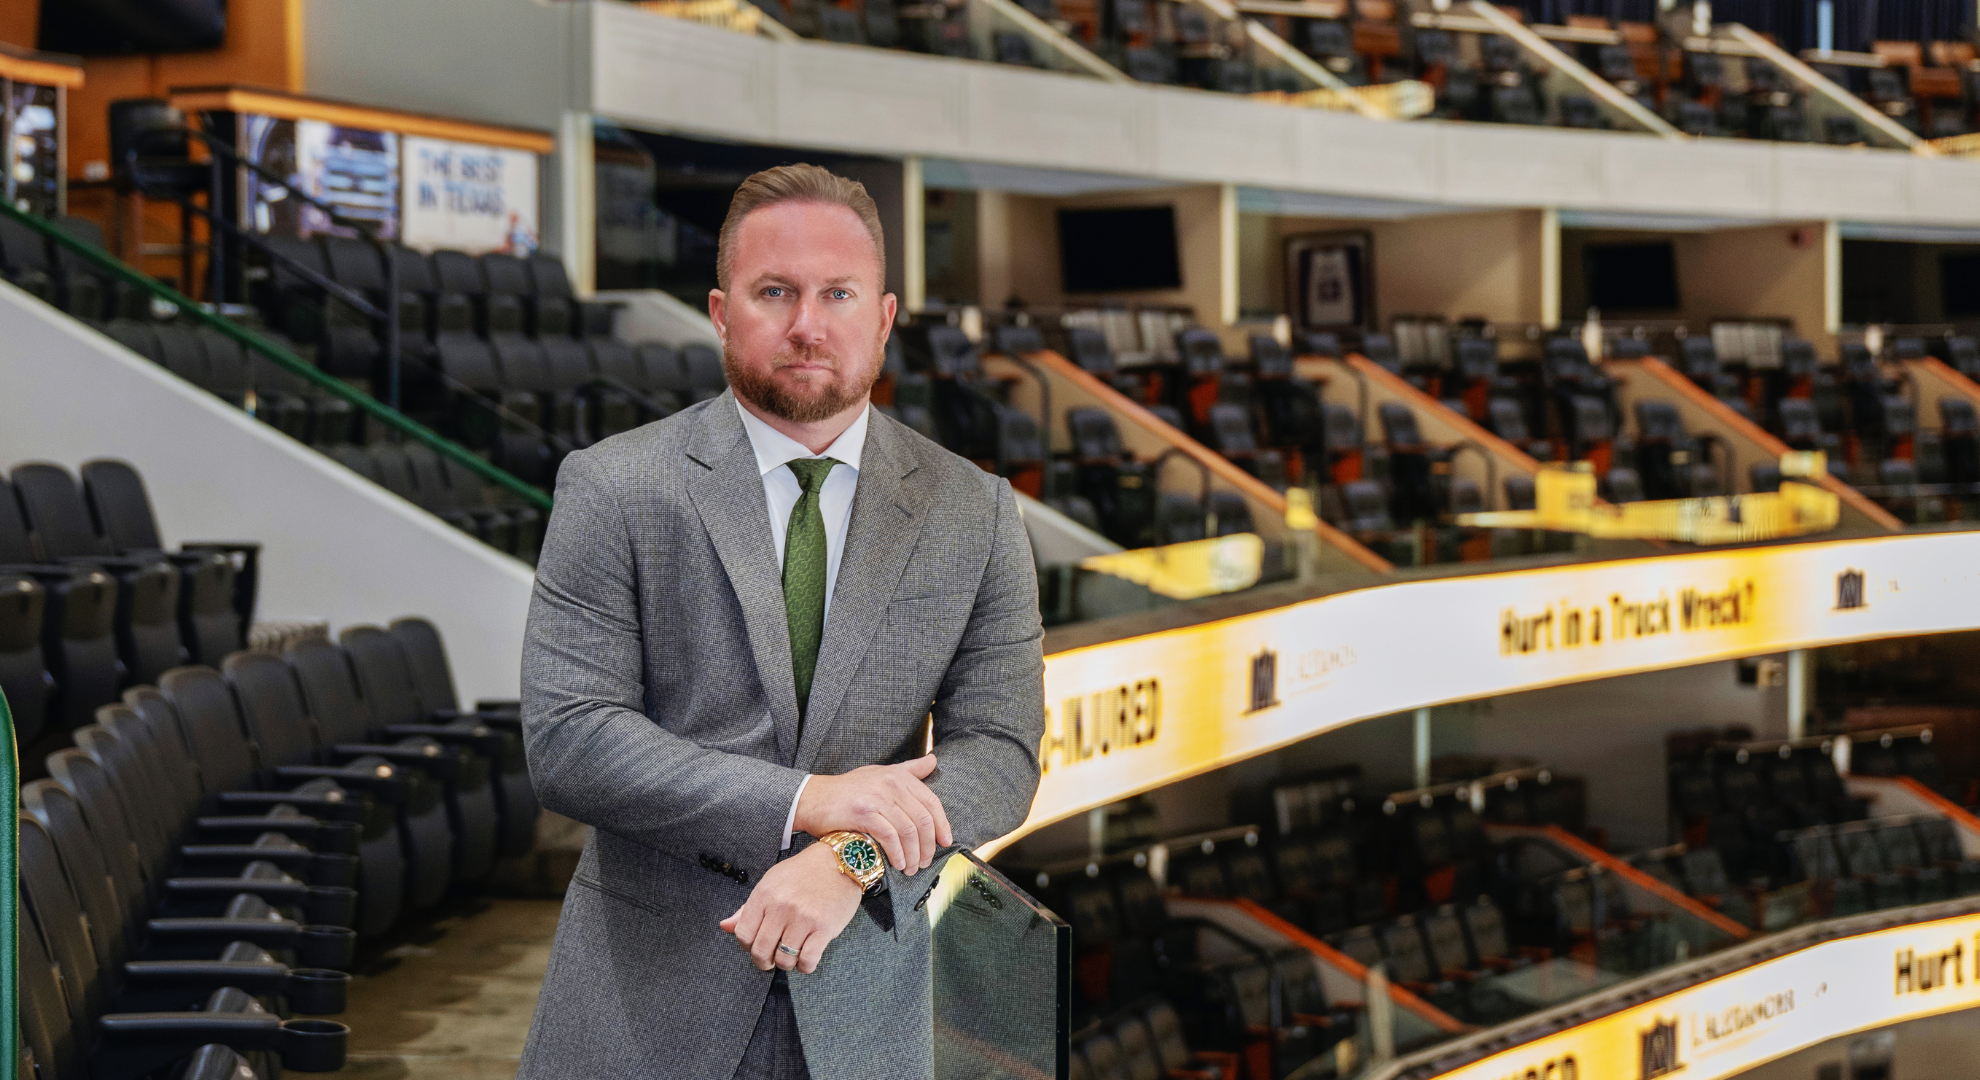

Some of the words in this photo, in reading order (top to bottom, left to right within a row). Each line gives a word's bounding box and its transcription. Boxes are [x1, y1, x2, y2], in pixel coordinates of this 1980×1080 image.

[418, 146, 452, 175] THE
[461, 152, 504, 181] BEST
[1500, 605, 1554, 656] Hurt
[1561, 599, 1583, 648] in
[1589, 605, 1603, 645] a
[1609, 590, 1671, 641] Truck
[1678, 576, 1758, 632] Wreck?
[1895, 939, 1964, 997] Hurt
